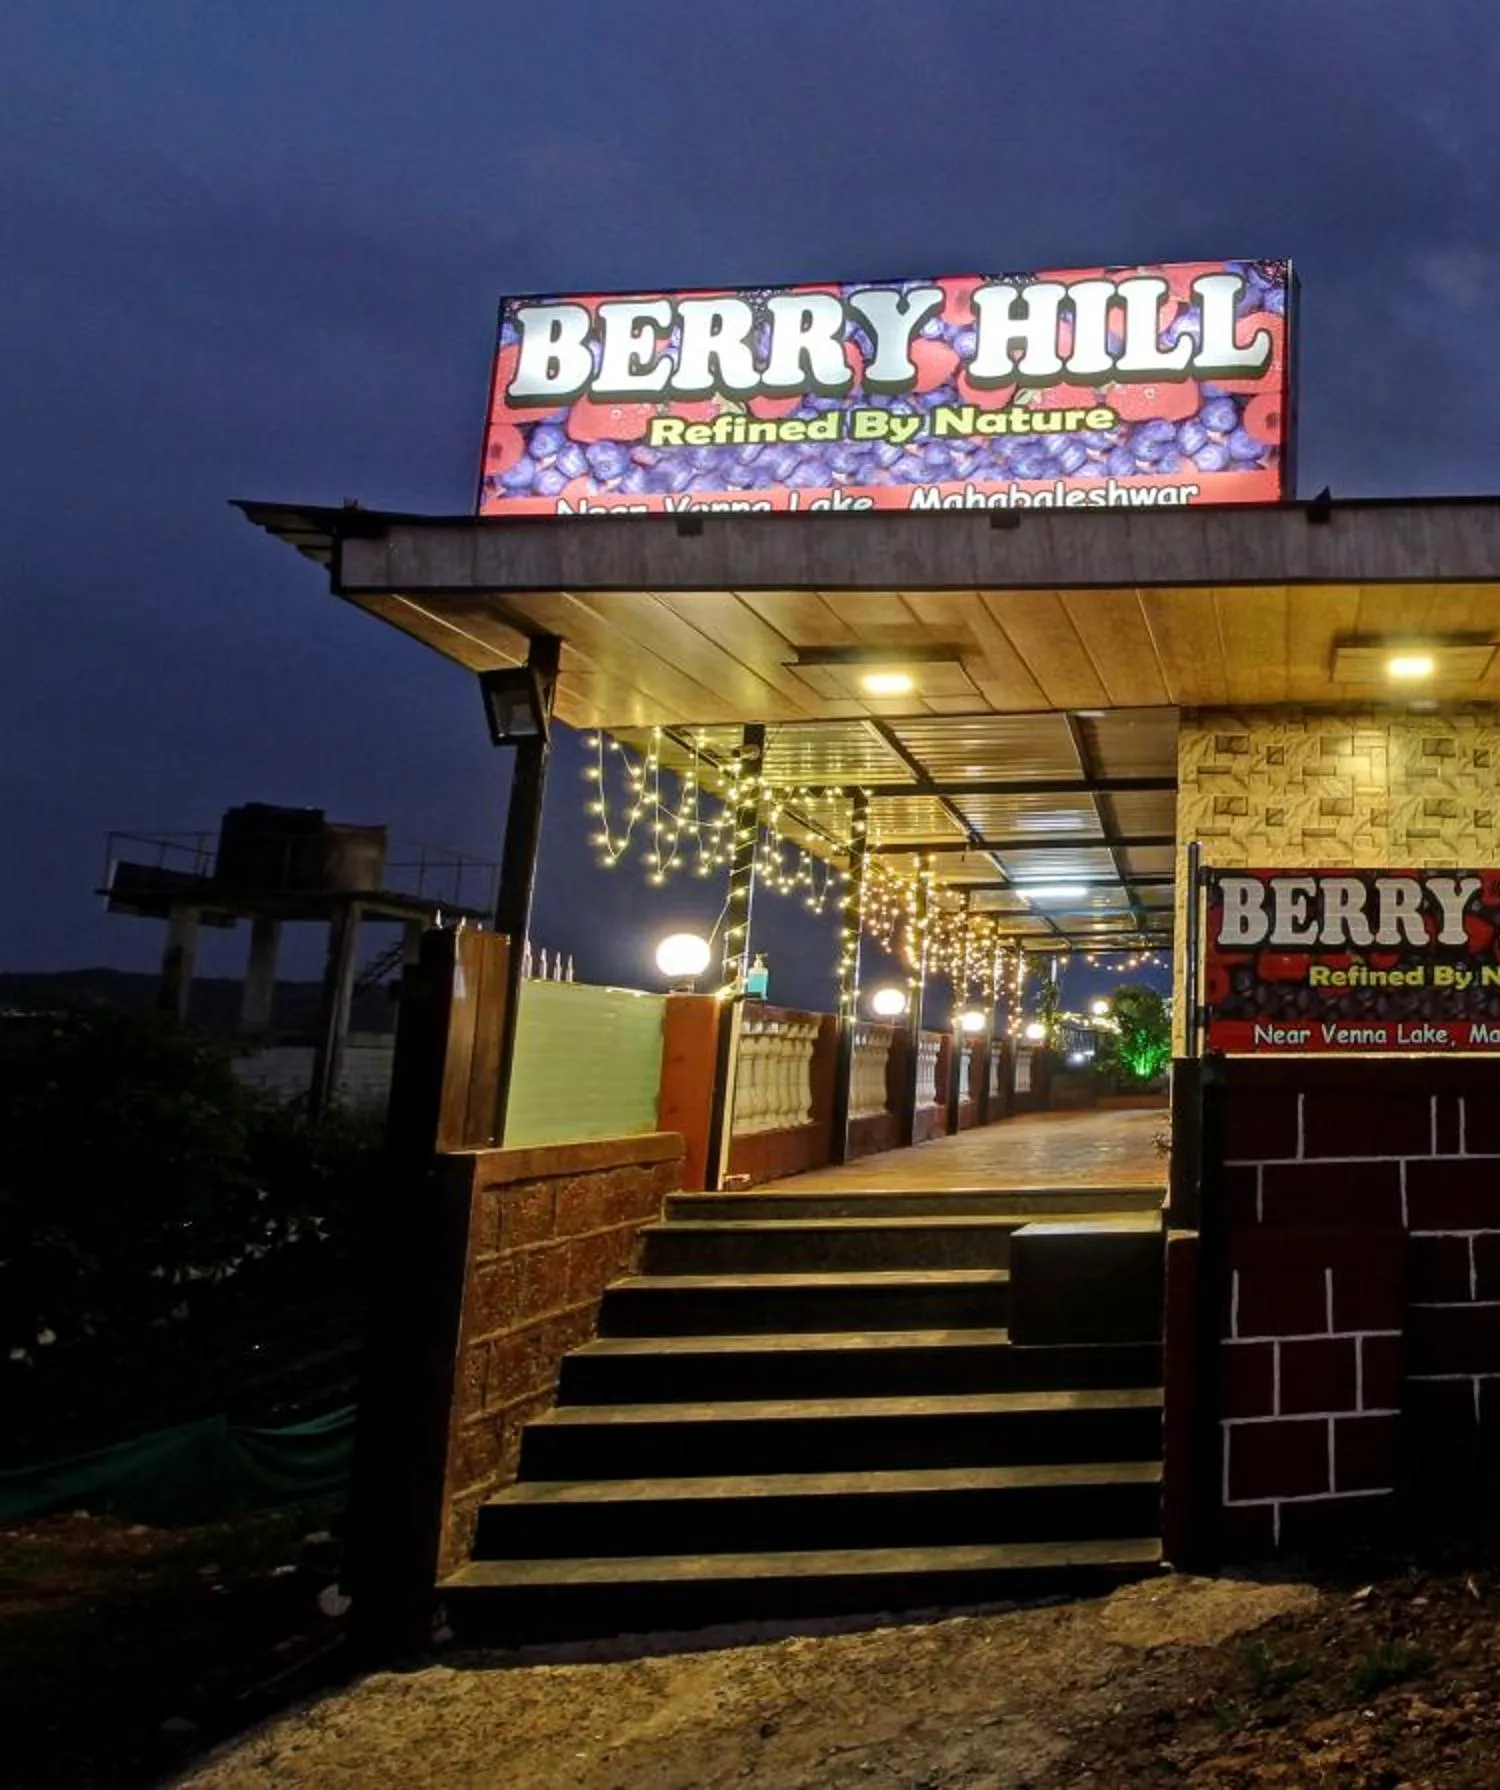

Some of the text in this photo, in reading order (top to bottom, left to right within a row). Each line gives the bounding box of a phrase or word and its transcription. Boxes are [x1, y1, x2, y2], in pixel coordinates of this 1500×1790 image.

[510, 274, 1274, 400] BERRY HILL
[649, 406, 1117, 447] Refined By Nature
[909, 478, 1200, 510] Mahabaleshwar
[1216, 877, 1482, 948] BERRY
[1308, 965, 1425, 987] Refined
[1433, 965, 1473, 991] By
[1253, 1024, 1312, 1045] Near
[1320, 1023, 1388, 1044] Venna
[1396, 1023, 1458, 1048] Lake,
